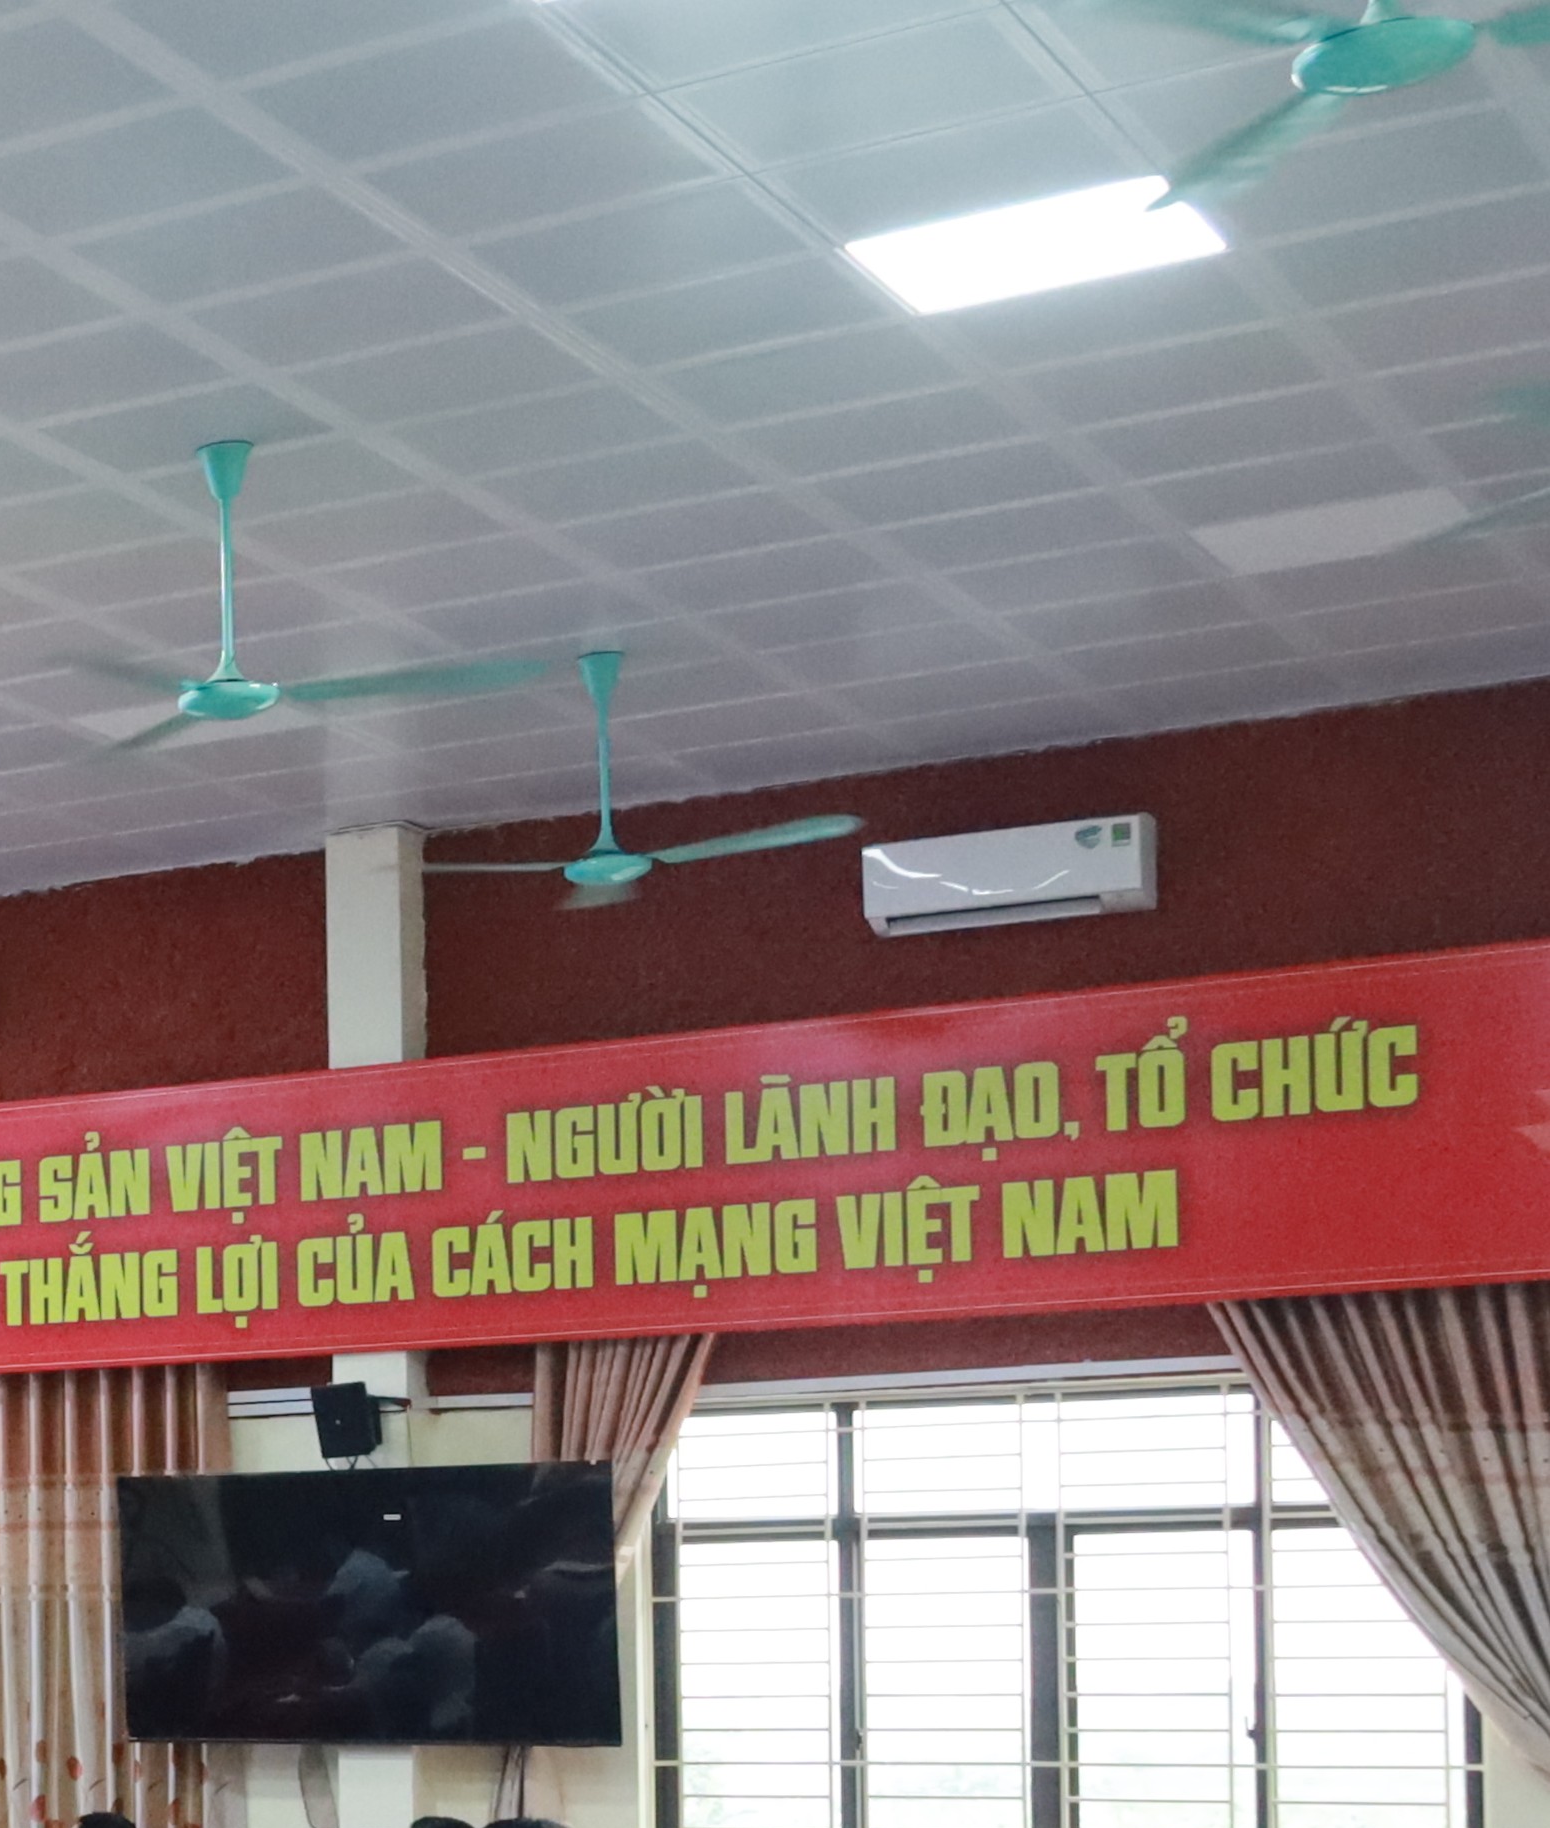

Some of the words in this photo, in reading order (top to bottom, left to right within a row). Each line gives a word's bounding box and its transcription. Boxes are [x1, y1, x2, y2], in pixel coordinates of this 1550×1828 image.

[39, 1133, 150, 1222] SẢN
[167, 1130, 282, 1222] VIỆT
[300, 1121, 442, 1200] NAM
[507, 1091, 703, 1182] NGƯỜI
[726, 1074, 895, 1163] LÃNH
[922, 1063, 1078, 1160] ĐẠO,
[1096, 1015, 1186, 1130] TỔ
[1211, 1016, 1418, 1121] CHỨC
[0, 1232, 178, 1325] THẮNG
[196, 1236, 279, 1328] LỢI
[297, 1215, 414, 1306] CỦA
[432, 1212, 593, 1296] CÁCH
[615, 1200, 817, 1297] MẠNG
[838, 1177, 979, 1282] VIỆT
[1002, 1170, 1178, 1257] NAM
